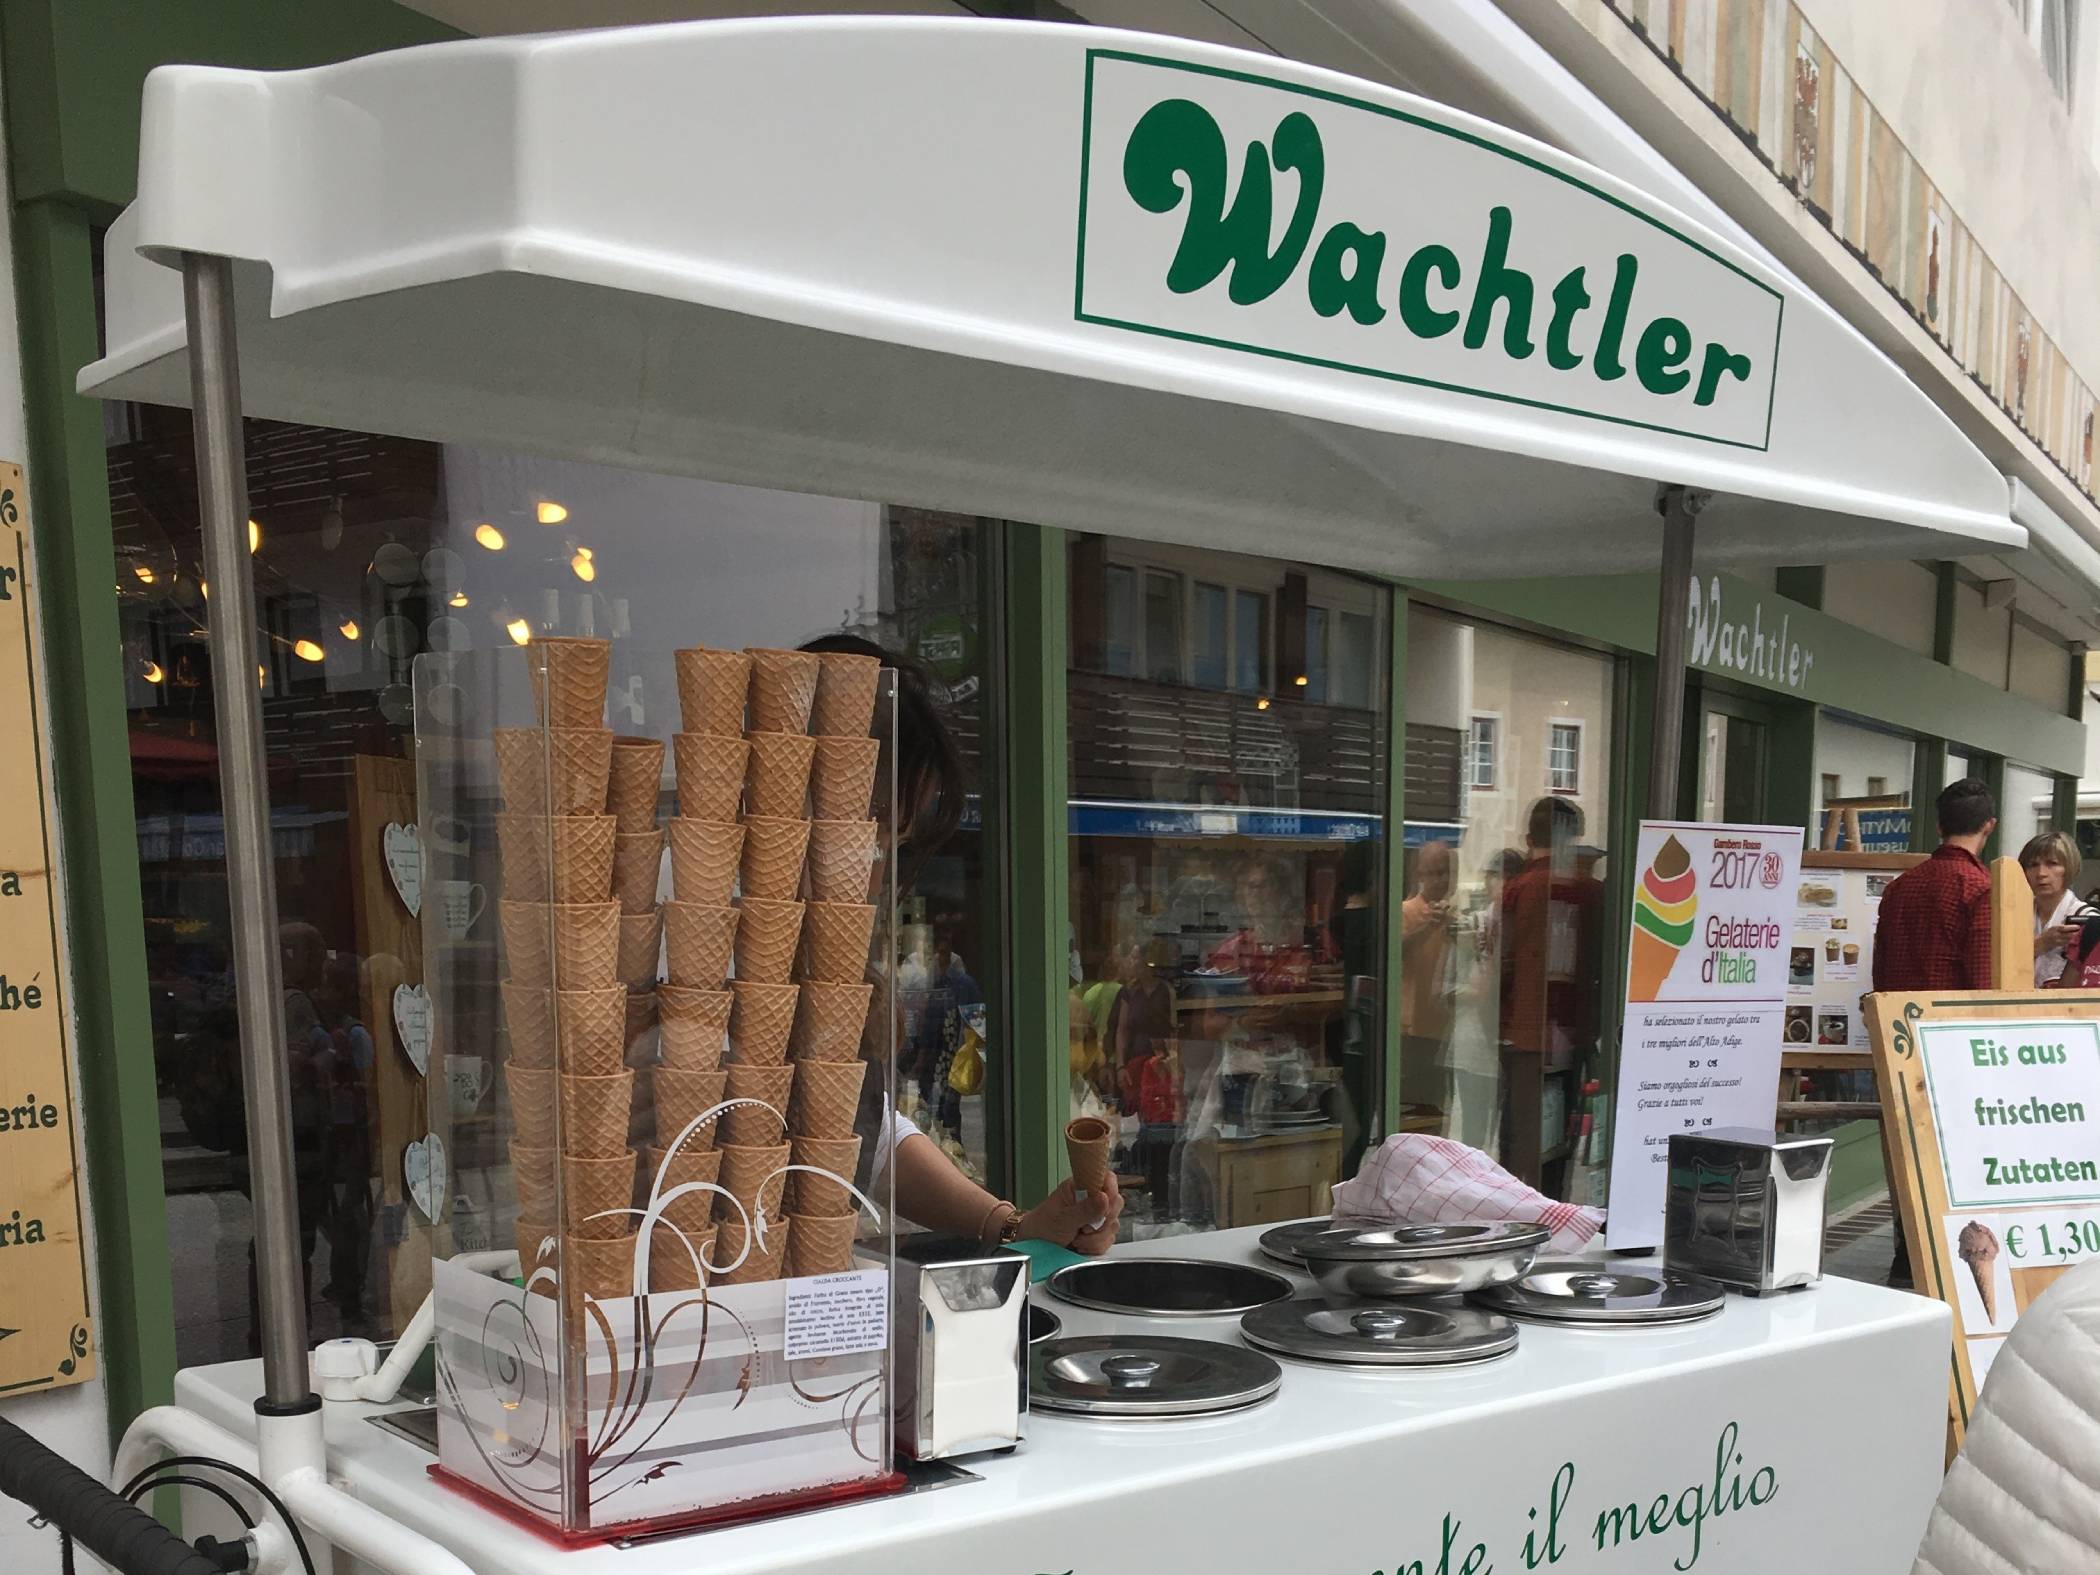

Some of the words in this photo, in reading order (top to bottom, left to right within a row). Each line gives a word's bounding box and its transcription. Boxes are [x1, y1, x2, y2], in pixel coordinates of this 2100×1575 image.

[1123, 98, 1752, 406] Wachtler
[1688, 576, 1814, 690] Wachtler
[1710, 851, 1760, 889] 2017
[1764, 855, 1779, 873] 30
[1706, 915, 1780, 949] Gelaterie
[1702, 951, 1756, 983] d'Italia
[1643, 1016, 1653, 1026] ha
[1655, 1015, 1695, 1026] selezionato
[1696, 1014, 1704, 1025] il
[1704, 1016, 1726, 1025] nostro
[1727, 1014, 1748, 1027] gelato
[1647, 1040, 1657, 1048] tre
[1659, 1036, 1687, 1051] migliori
[1720, 1034, 1743, 1049] Adige.
[1970, 1039, 2009, 1066] Eis
[2018, 1043, 2067, 1065] aus
[1638, 1080, 1661, 1091] Siamo
[1663, 1078, 1698, 1092] orgogliosi
[1699, 1077, 1712, 1088] del
[1711, 1077, 1743, 1088] successo!
[1637, 1098, 1662, 1111] Grazie
[1671, 1099, 1688, 1107] tutti
[1690, 1096, 1704, 1106] voi!
[1975, 1096, 2085, 1126] frischen
[1983, 1157, 2098, 1185] Zutaten
[2006, 1225, 2028, 1258] €
[2036, 1220, 2100, 1262] 1,30
[1520, 1461, 1574, 1570] il
[1592, 1421, 1779, 1571] meglio
